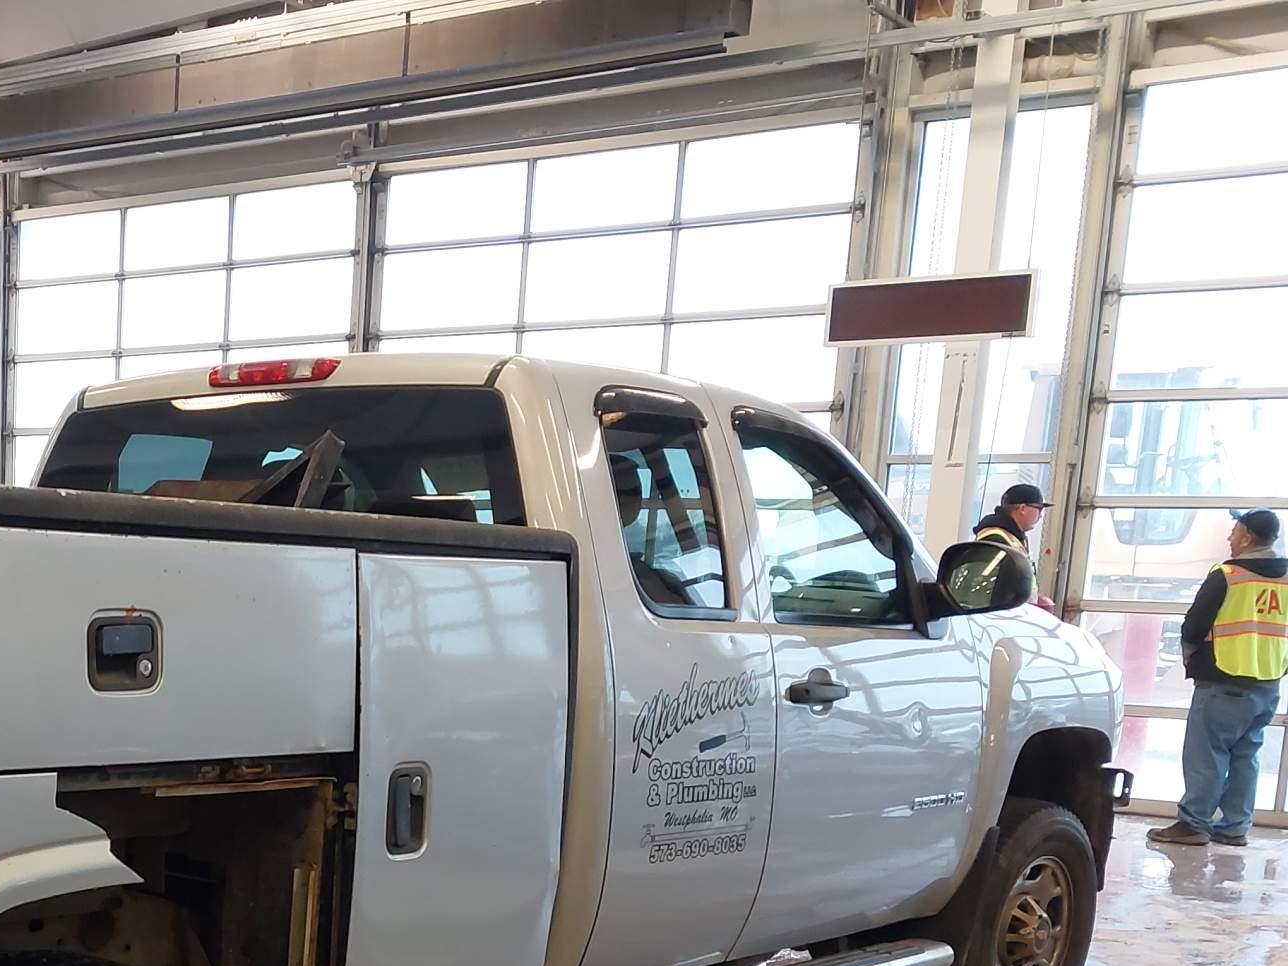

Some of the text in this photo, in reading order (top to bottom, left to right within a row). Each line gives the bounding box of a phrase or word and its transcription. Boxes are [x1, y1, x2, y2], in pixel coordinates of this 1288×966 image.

[648, 752, 756, 782] Construction
[646, 783, 661, 807] &
[665, 778, 743, 805] Plumbing
[664, 805, 738, 830] Westphalia MO
[648, 833, 747, 864] 573-690-8035
